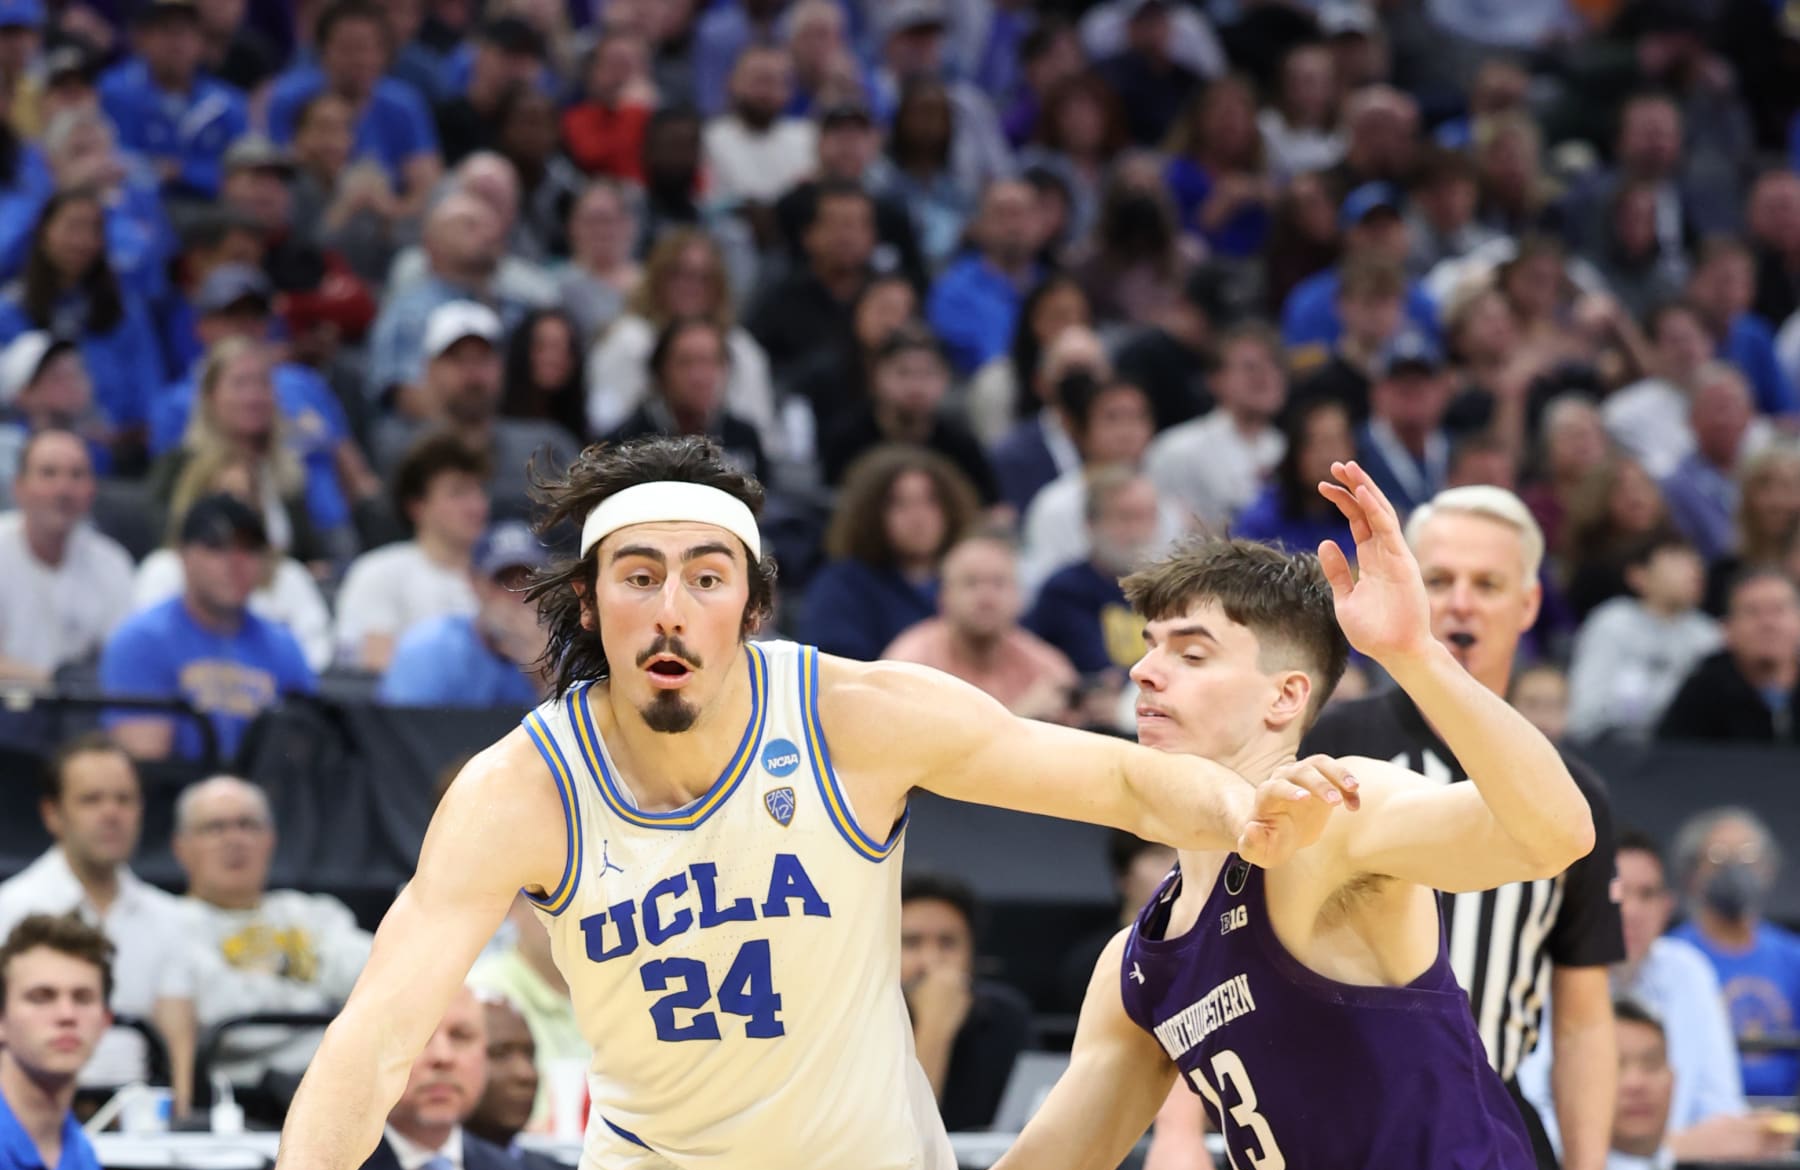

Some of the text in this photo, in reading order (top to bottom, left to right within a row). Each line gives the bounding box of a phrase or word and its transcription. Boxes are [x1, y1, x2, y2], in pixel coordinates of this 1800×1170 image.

[767, 753, 799, 770] NCAA
[775, 804, 791, 820] 12
[580, 854, 831, 963] UCLA
[640, 939, 785, 1042] 24
